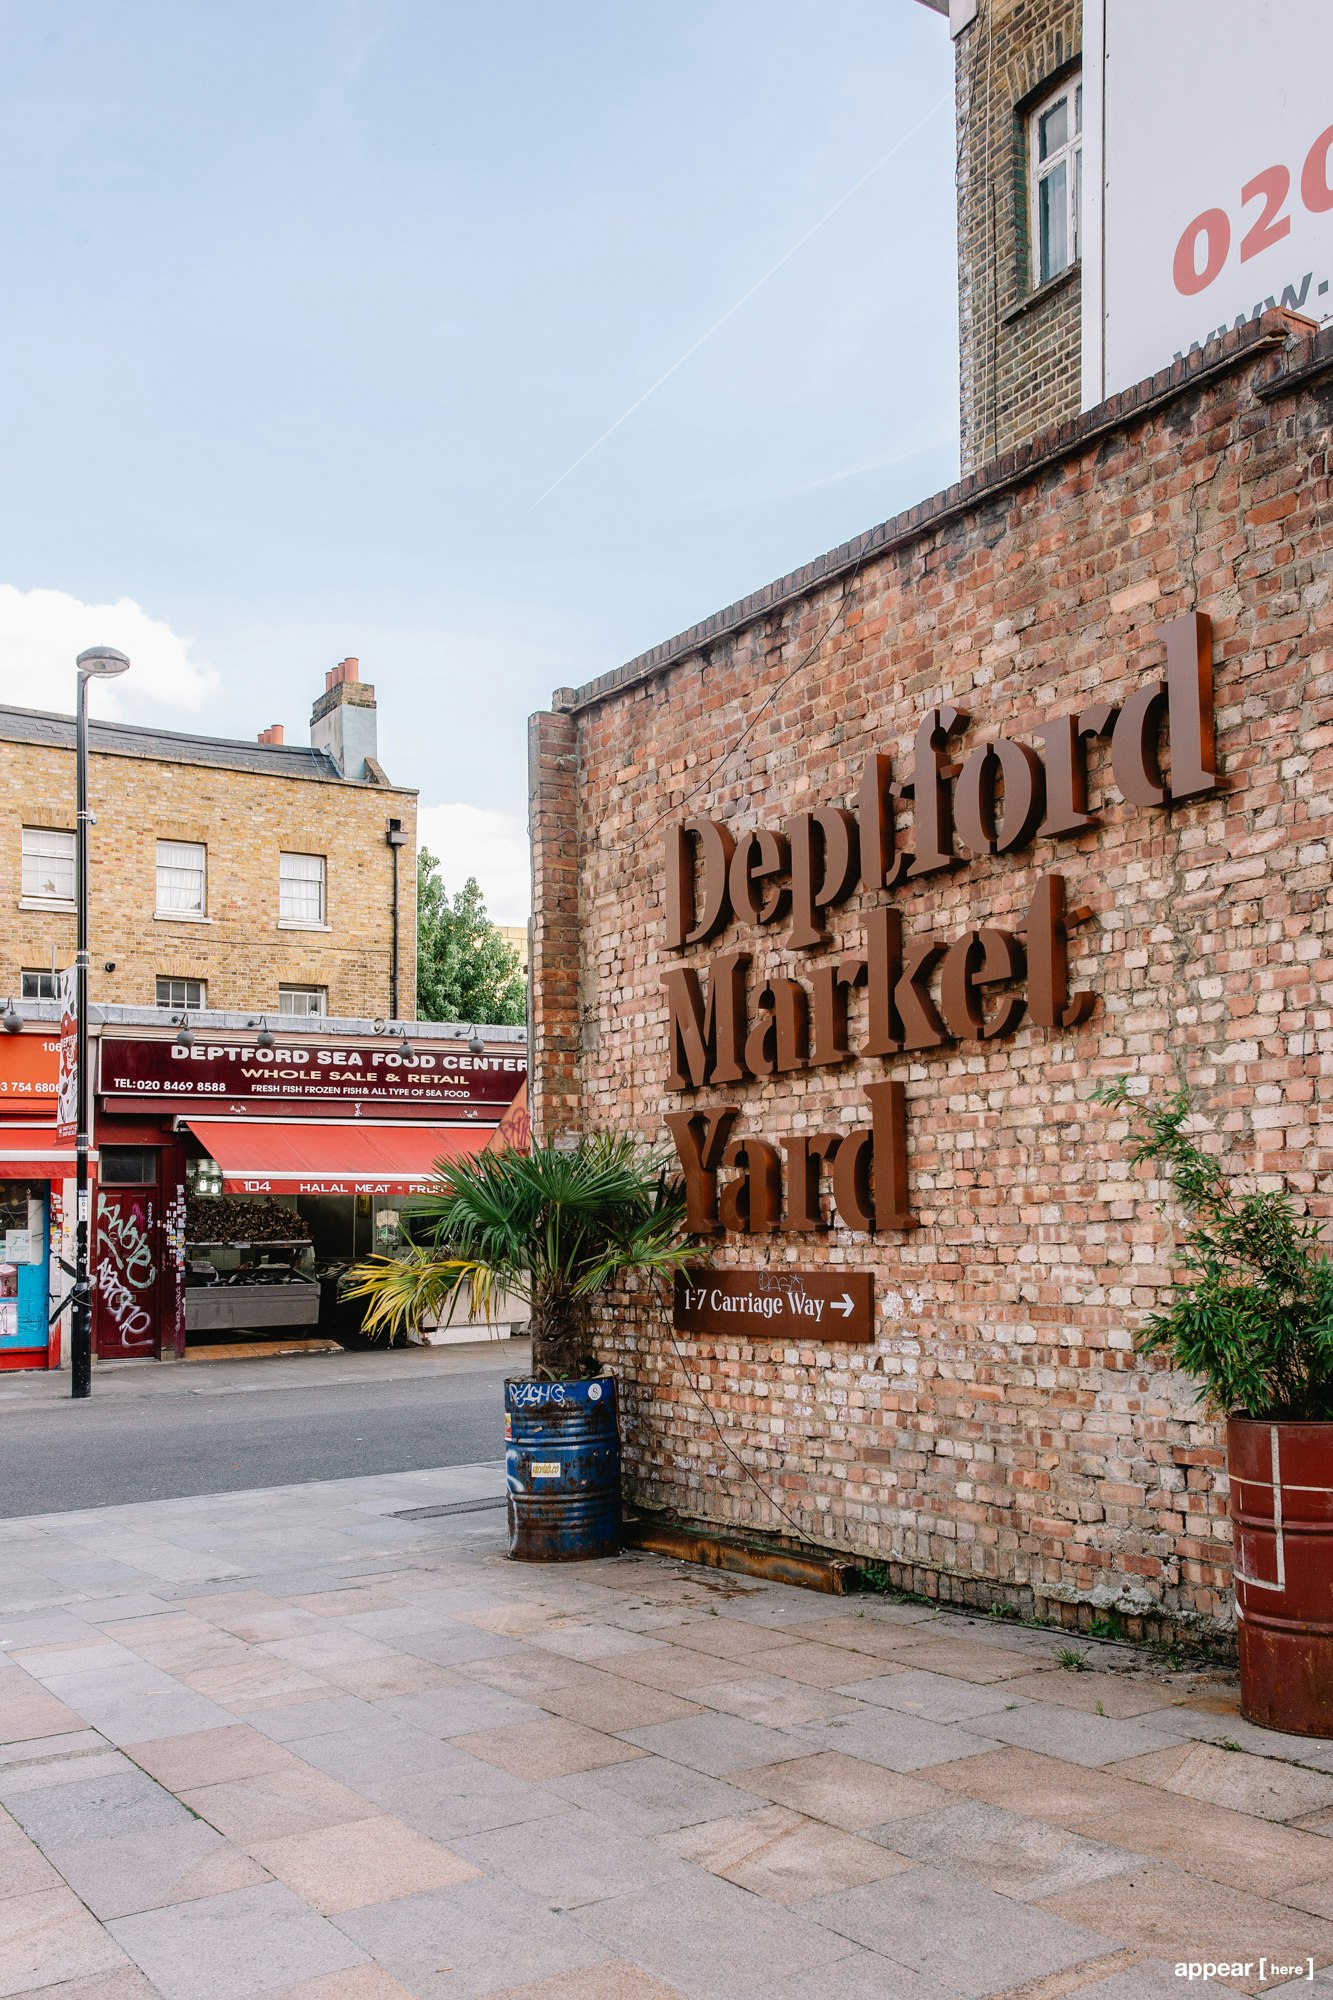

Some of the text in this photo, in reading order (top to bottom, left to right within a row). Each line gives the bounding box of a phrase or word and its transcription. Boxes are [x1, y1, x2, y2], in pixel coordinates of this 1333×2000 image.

[661, 611, 1230, 951] Deptford
[660, 874, 1101, 1092] Market
[42, 1042, 61, 1052] 106
[171, 1045, 527, 1072] DEPTFORD SEA FOOD CENTER
[241, 1068, 470, 1085] WHOLE SALE & RETAIL
[11, 1082, 32, 1092] 754
[163, 1081, 194, 1091] 8469
[197, 1082, 226, 1092] 8588
[251, 1084, 280, 1093] FRESH
[283, 1085, 302, 1093] FISH
[304, 1086, 341, 1094] FROZEN
[389, 1088, 410, 1096] TYPE
[425, 1089, 442, 1097] SEA
[444, 1090, 470, 1098] FOOD
[664, 1081, 919, 1234] Yard
[243, 1180, 271, 1192] 104
[300, 1183, 348, 1193] HALAL
[355, 1184, 391, 1193] MEAT
[684, 1288, 825, 1322] 1-7 Carriage Way
